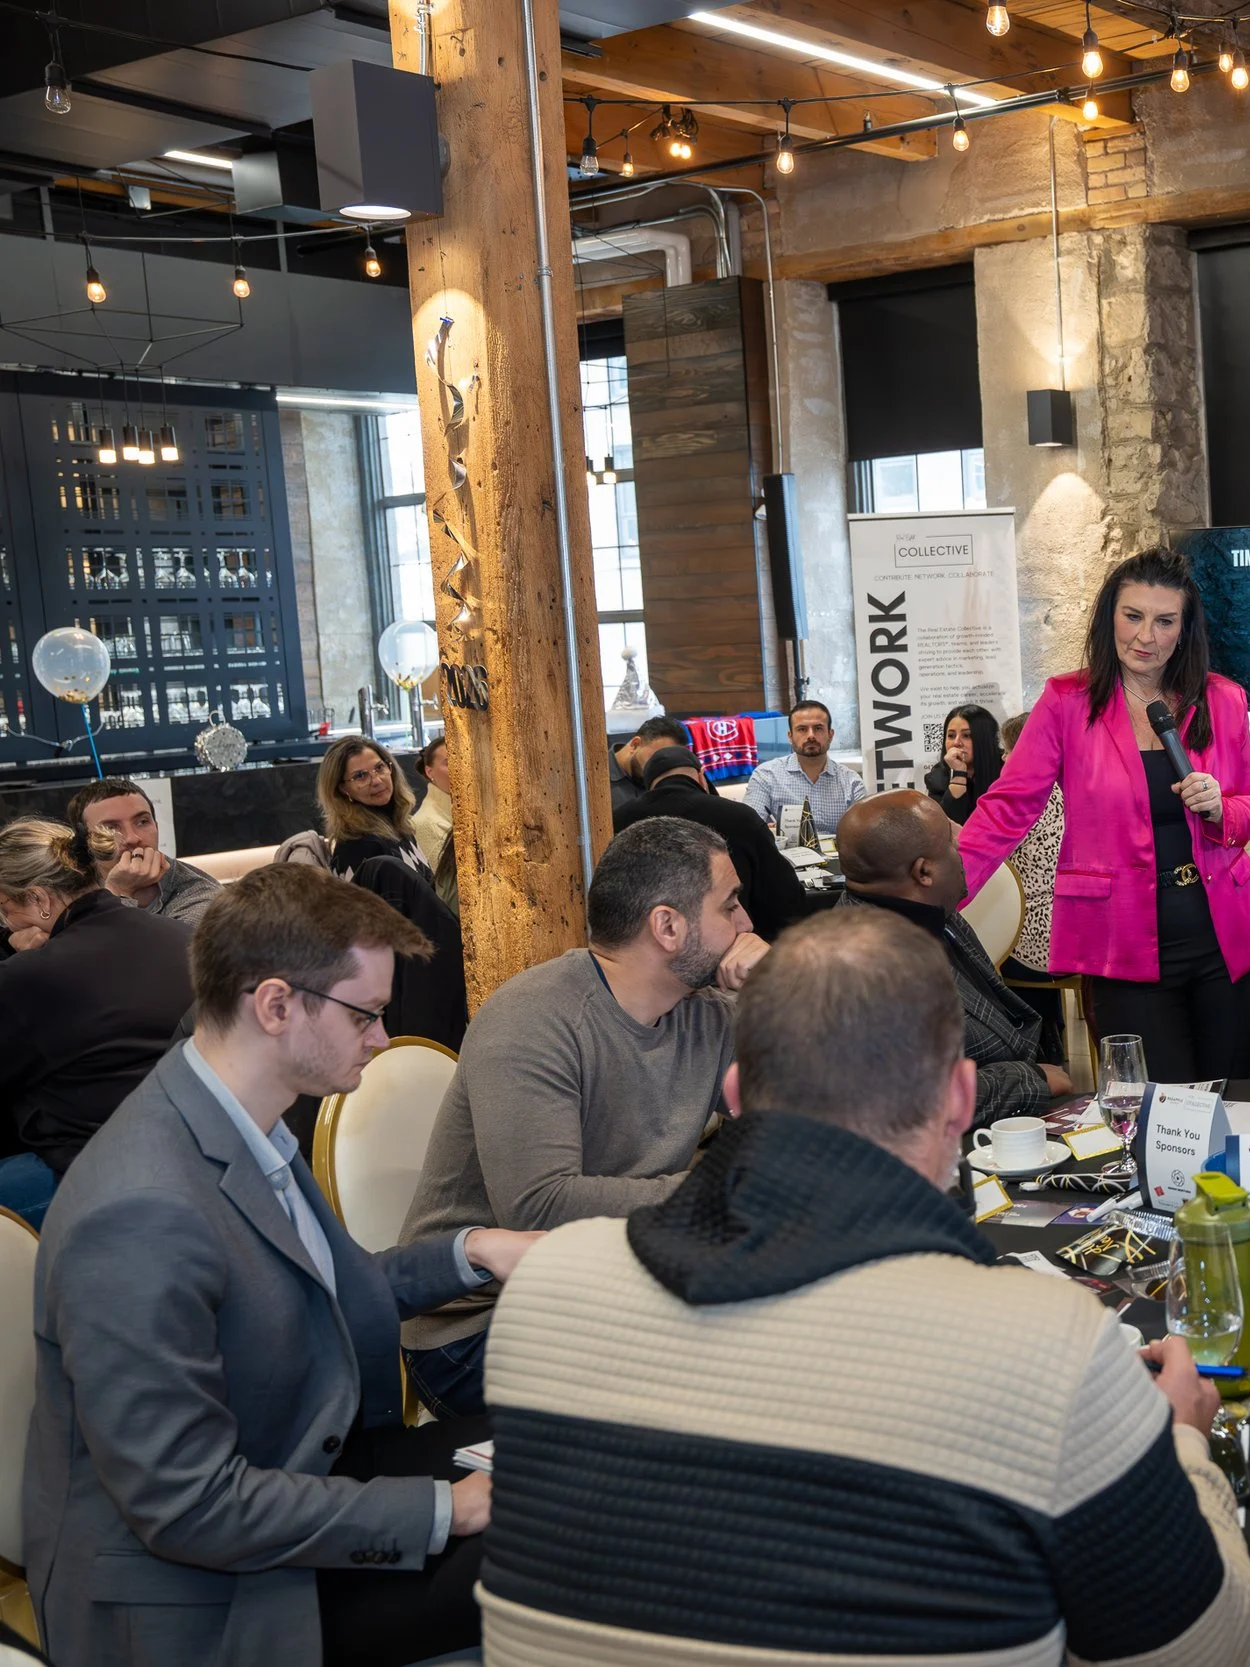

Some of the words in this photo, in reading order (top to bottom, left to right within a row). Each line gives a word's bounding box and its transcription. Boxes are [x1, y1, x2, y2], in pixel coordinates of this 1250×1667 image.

[898, 545, 969, 557] COLLECTIVE
[440, 662, 489, 711] 2026
[867, 591, 915, 793] TWORK
[1156, 1123, 1182, 1137] Thank
[1183, 1128, 1201, 1141] You
[1155, 1140, 1196, 1156] Sponsors
